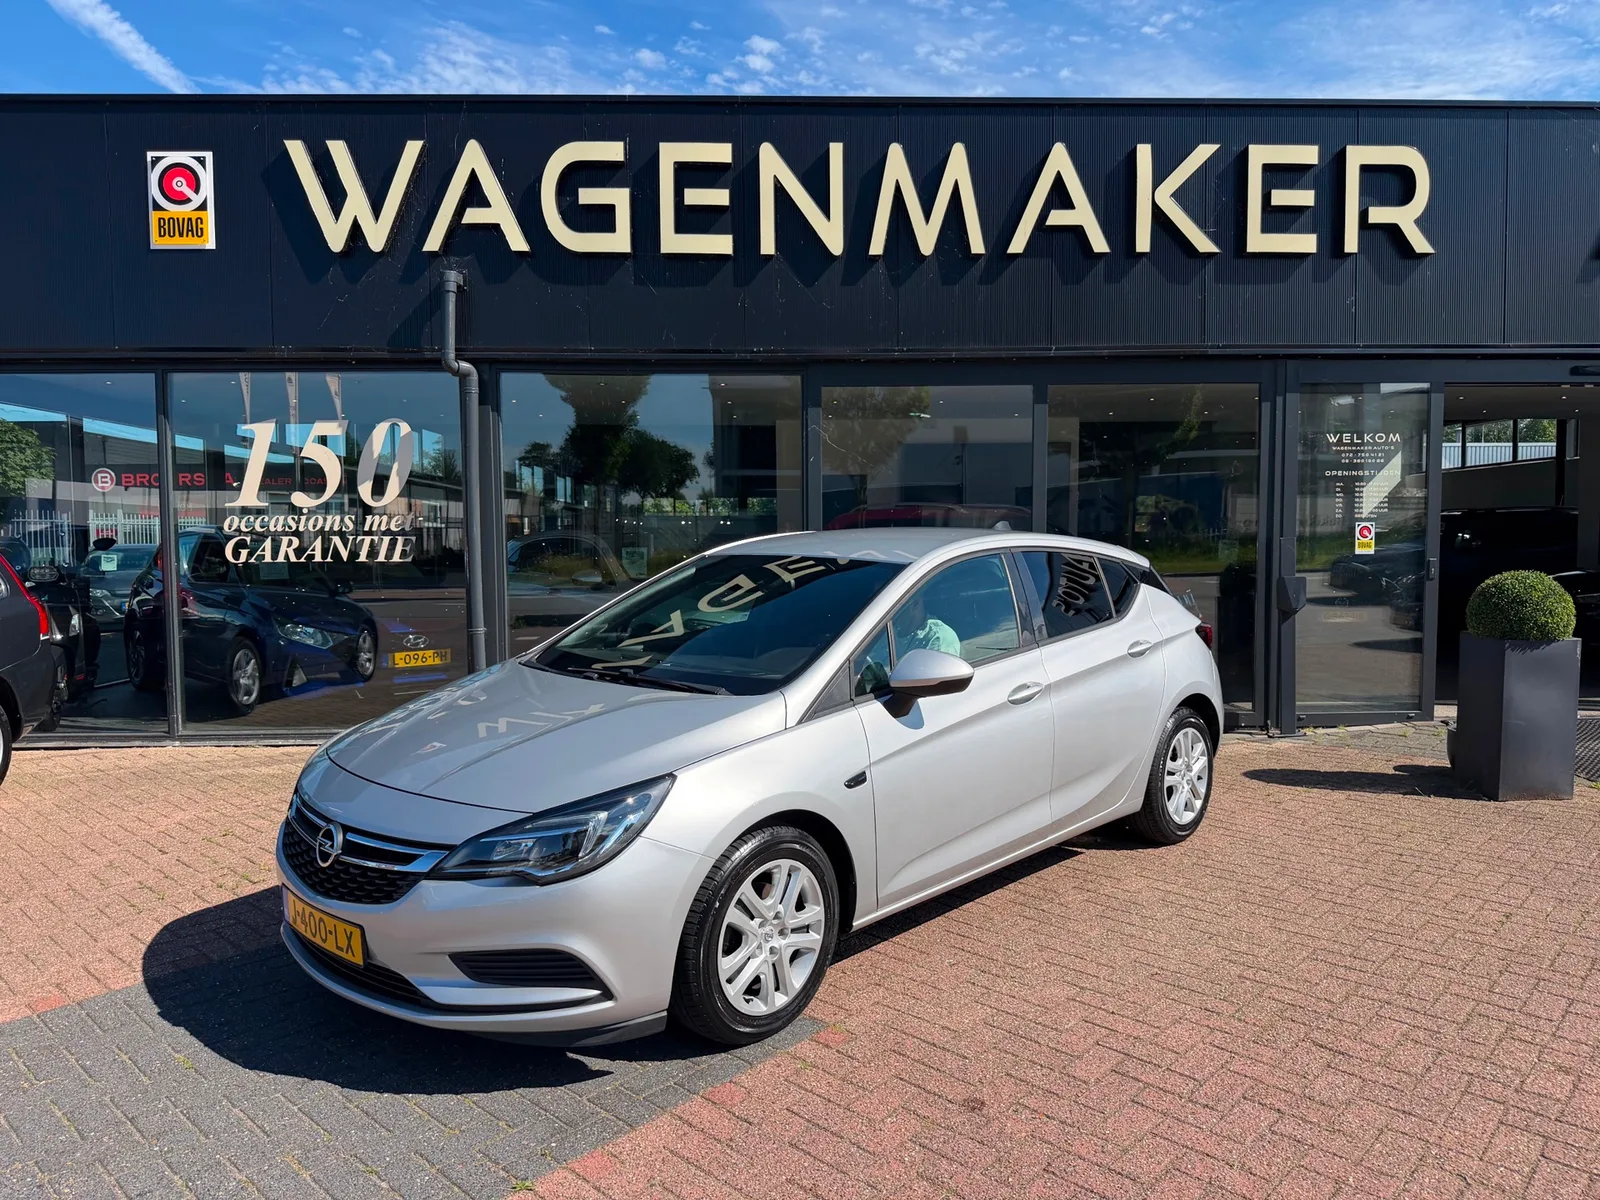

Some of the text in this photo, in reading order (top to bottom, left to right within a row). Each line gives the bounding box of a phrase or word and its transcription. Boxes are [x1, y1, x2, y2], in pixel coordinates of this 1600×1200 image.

[283, 138, 1436, 255] WAGENMAKER
[158, 217, 204, 238] BOVAG
[1326, 433, 1401, 443] WELKOM
[224, 418, 414, 508] 150
[223, 508, 415, 532] occasions met
[224, 536, 416, 564] GARANTIE
[392, 651, 448, 666] L-096-PH
[291, 899, 356, 958] J-400-LX
